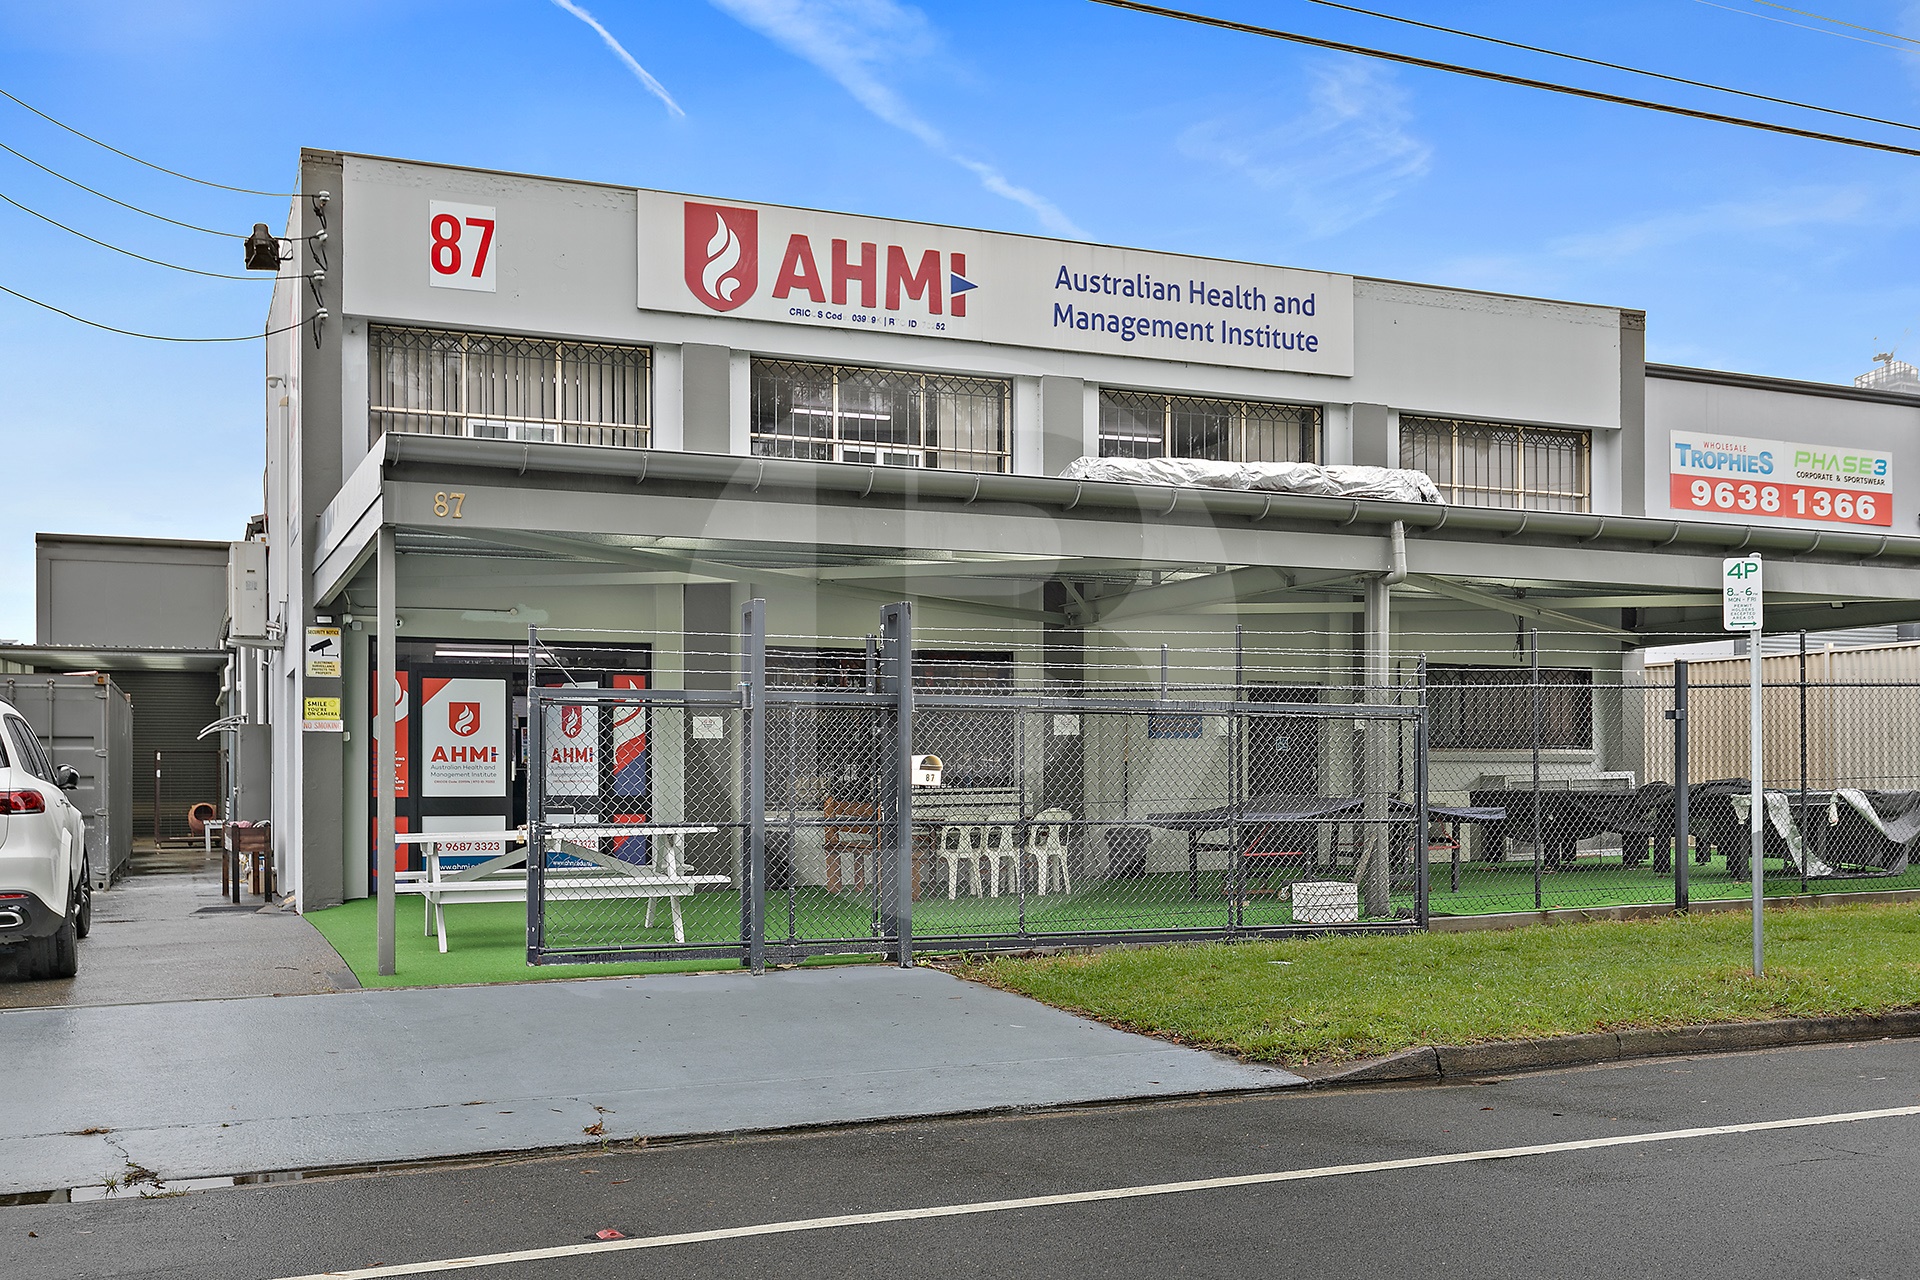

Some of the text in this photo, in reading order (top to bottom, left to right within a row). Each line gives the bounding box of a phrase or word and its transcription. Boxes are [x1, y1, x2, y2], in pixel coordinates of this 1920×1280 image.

[431, 213, 495, 278] 87
[772, 234, 967, 317] AHMI
[1054, 264, 1316, 317] Australian Health and
[789, 307, 824, 319] CRICS
[1053, 302, 1319, 353] Management Institute
[1703, 441, 1747, 453] WHOLESALE
[1675, 442, 1774, 475] TROPHIES
[1796, 471, 1833, 482] CORPORATE
[1843, 475, 1886, 486] SPORTSWEAR
[433, 491, 466, 518] 87
[1690, 479, 1876, 521] 9638 1366
[1727, 562, 1758, 579] 4P
[431, 745, 498, 763] AHMI
[430, 771, 471, 779] Management
[925, 773, 935, 782] 87
[445, 841, 472, 852] 9687
[474, 841, 500, 851] 3323
